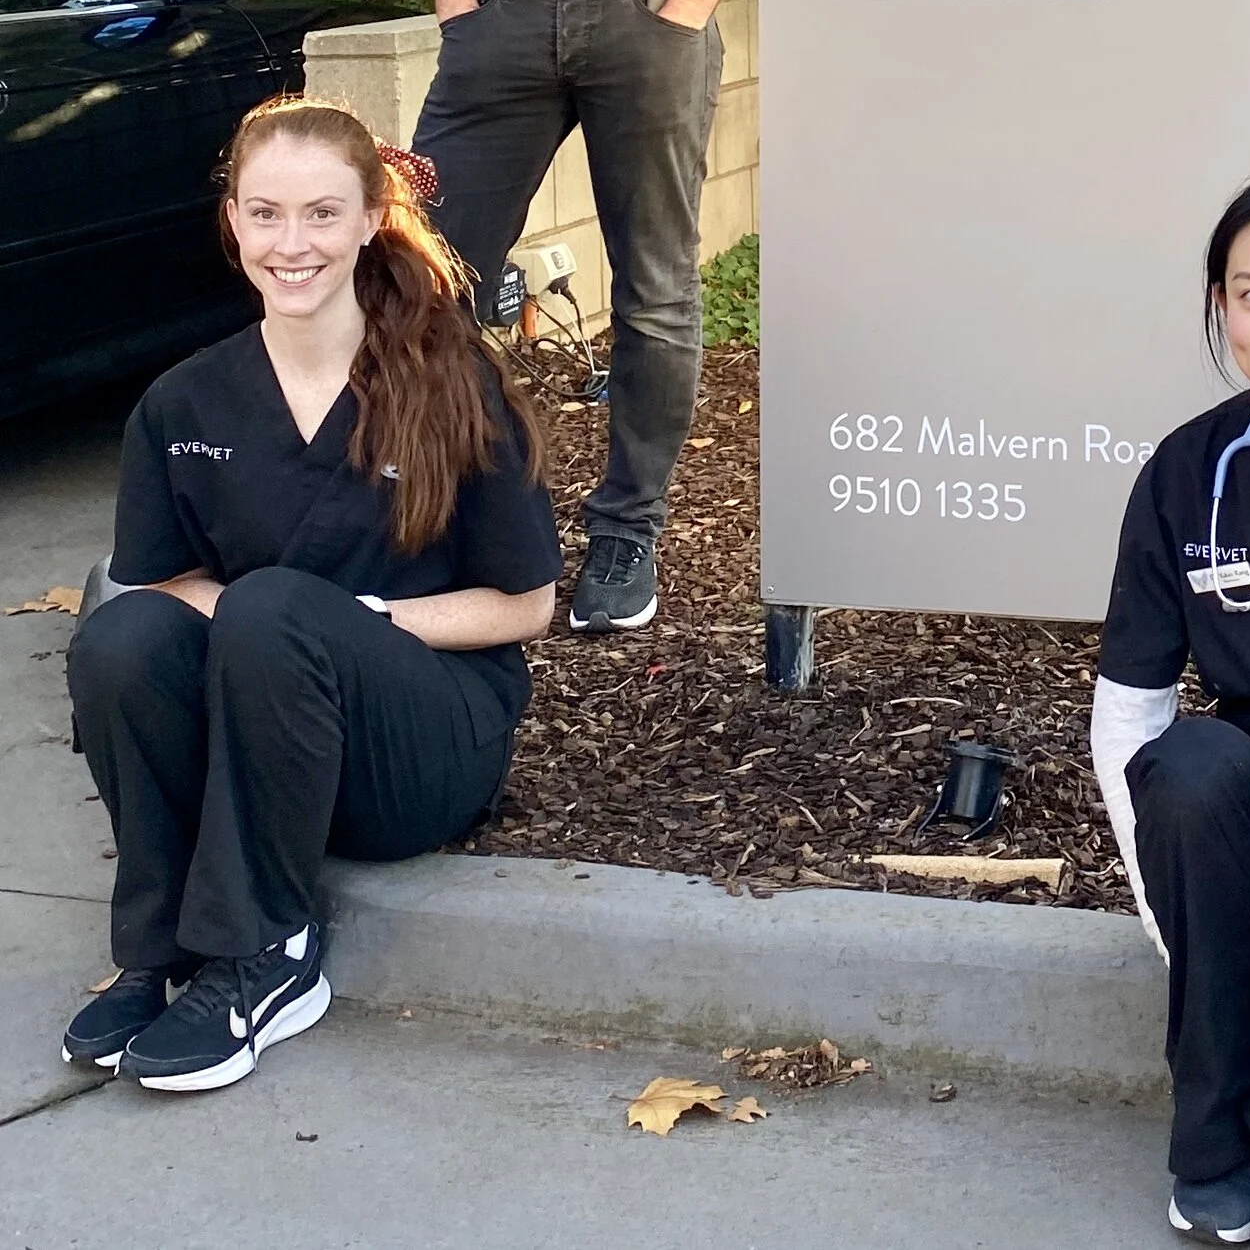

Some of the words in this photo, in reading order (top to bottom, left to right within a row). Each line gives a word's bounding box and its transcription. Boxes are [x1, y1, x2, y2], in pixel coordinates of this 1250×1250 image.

[167, 441, 233, 461] EVERVET
[829, 412, 904, 453] 682
[917, 415, 1068, 461] Malvern
[1084, 423, 1154, 465] Roa
[828, 474, 921, 516] 9510
[935, 480, 1027, 522] 1335
[1183, 543, 1248, 562] EVERVET
